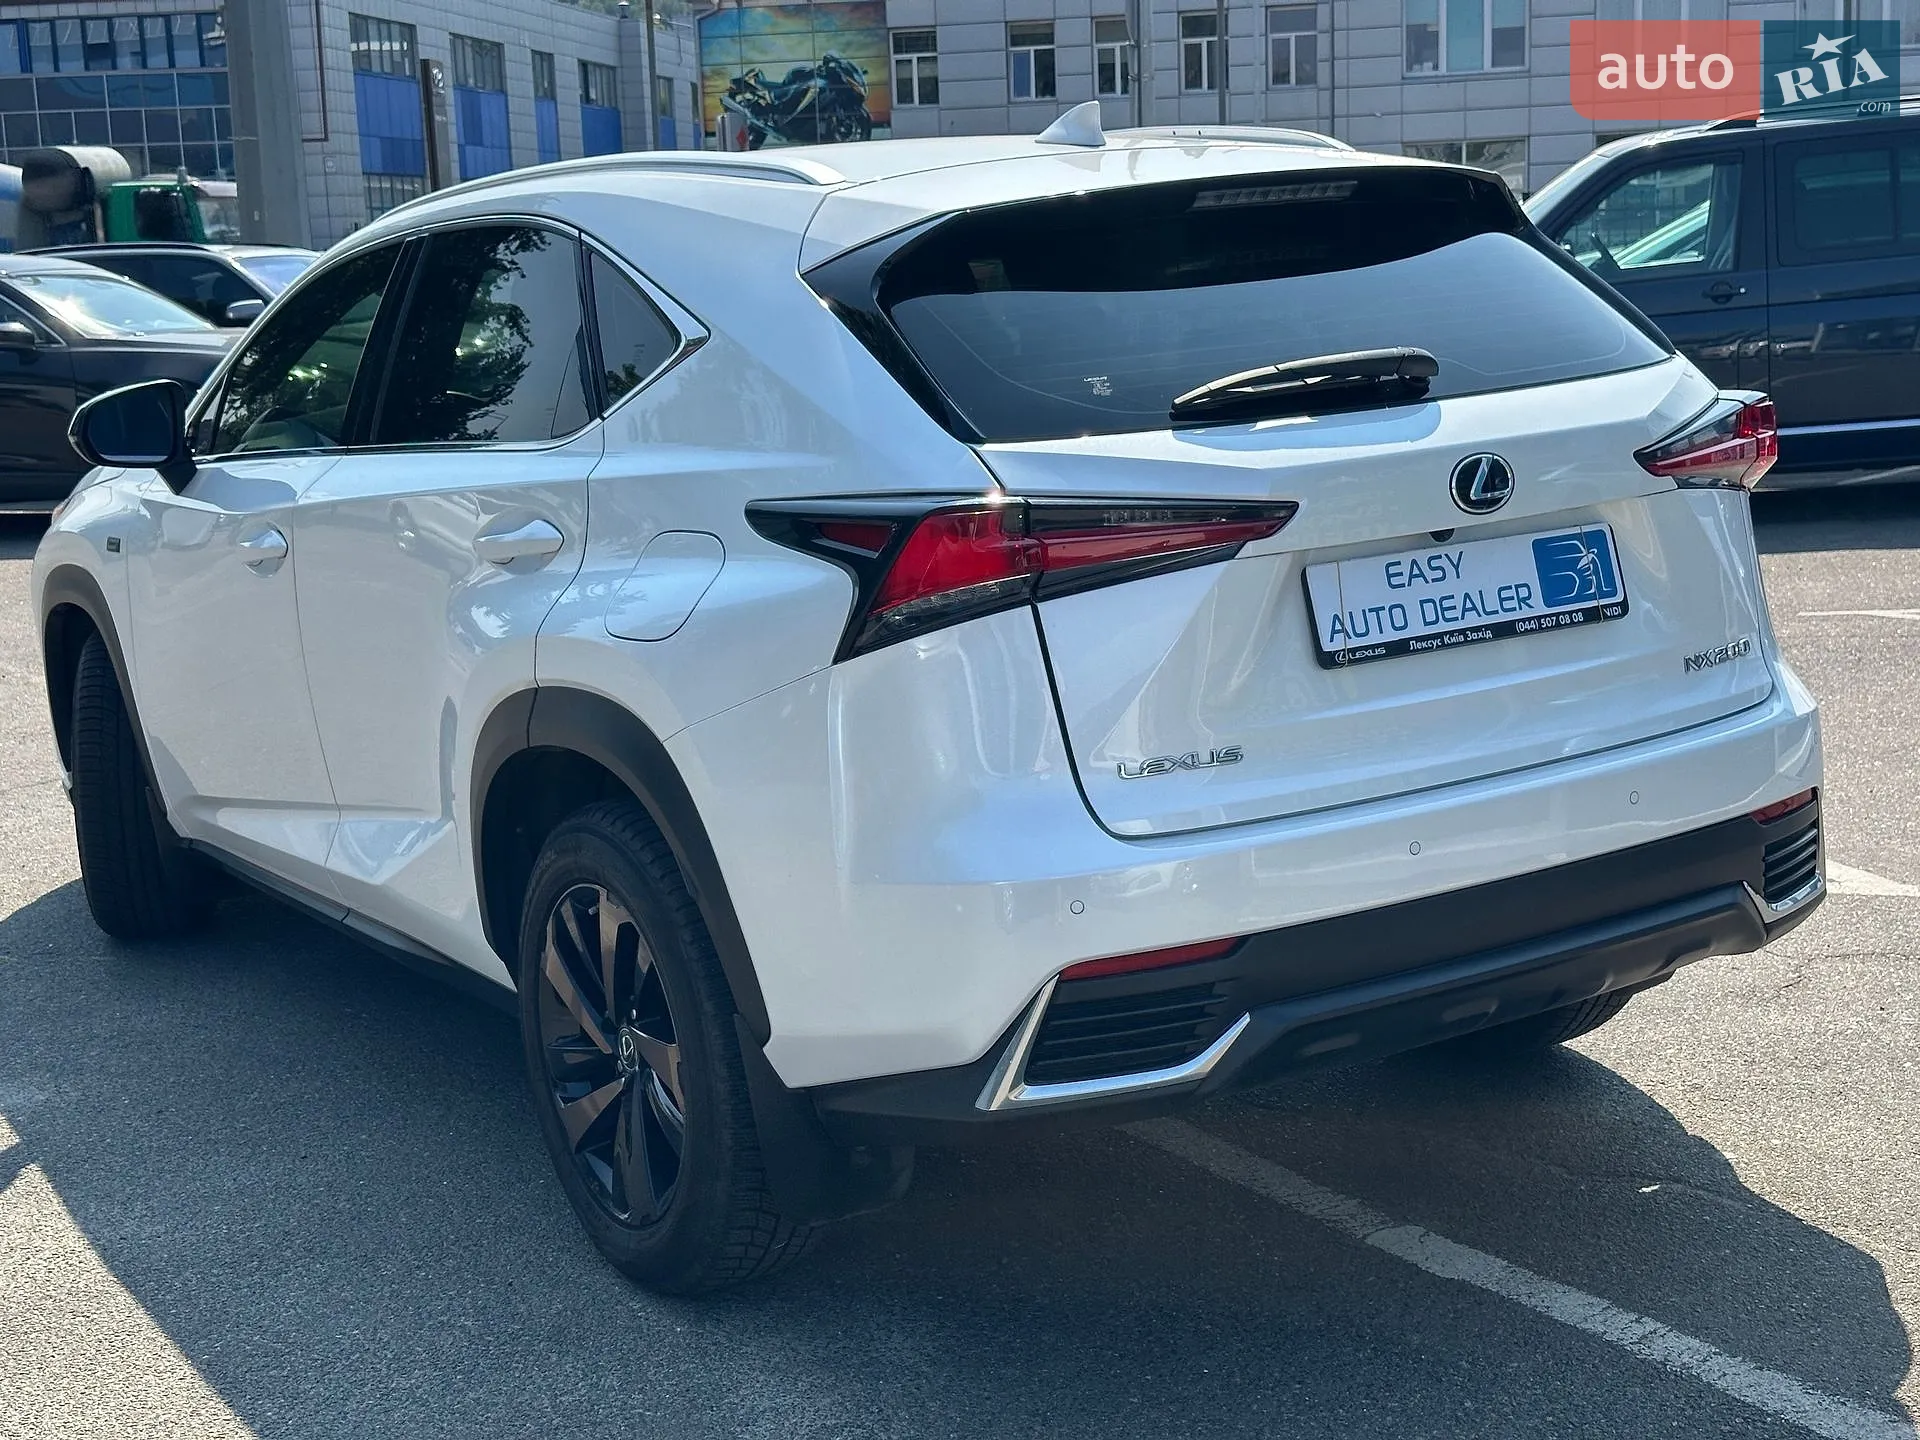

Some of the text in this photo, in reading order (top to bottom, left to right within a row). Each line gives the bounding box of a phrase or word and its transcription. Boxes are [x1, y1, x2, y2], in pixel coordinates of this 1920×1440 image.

[1384, 550, 1464, 590] EASY
[1329, 582, 1535, 643] AUTO DEALER
[1515, 611, 1584, 633] (044) 507 08 08
[1603, 605, 1622, 617] VIDI
[1349, 646, 1386, 659] LEXUS
[1409, 627, 1493, 650] Лексус Київ Захід
[1683, 636, 1751, 674] NX200
[1117, 744, 1244, 780] LEXUS
